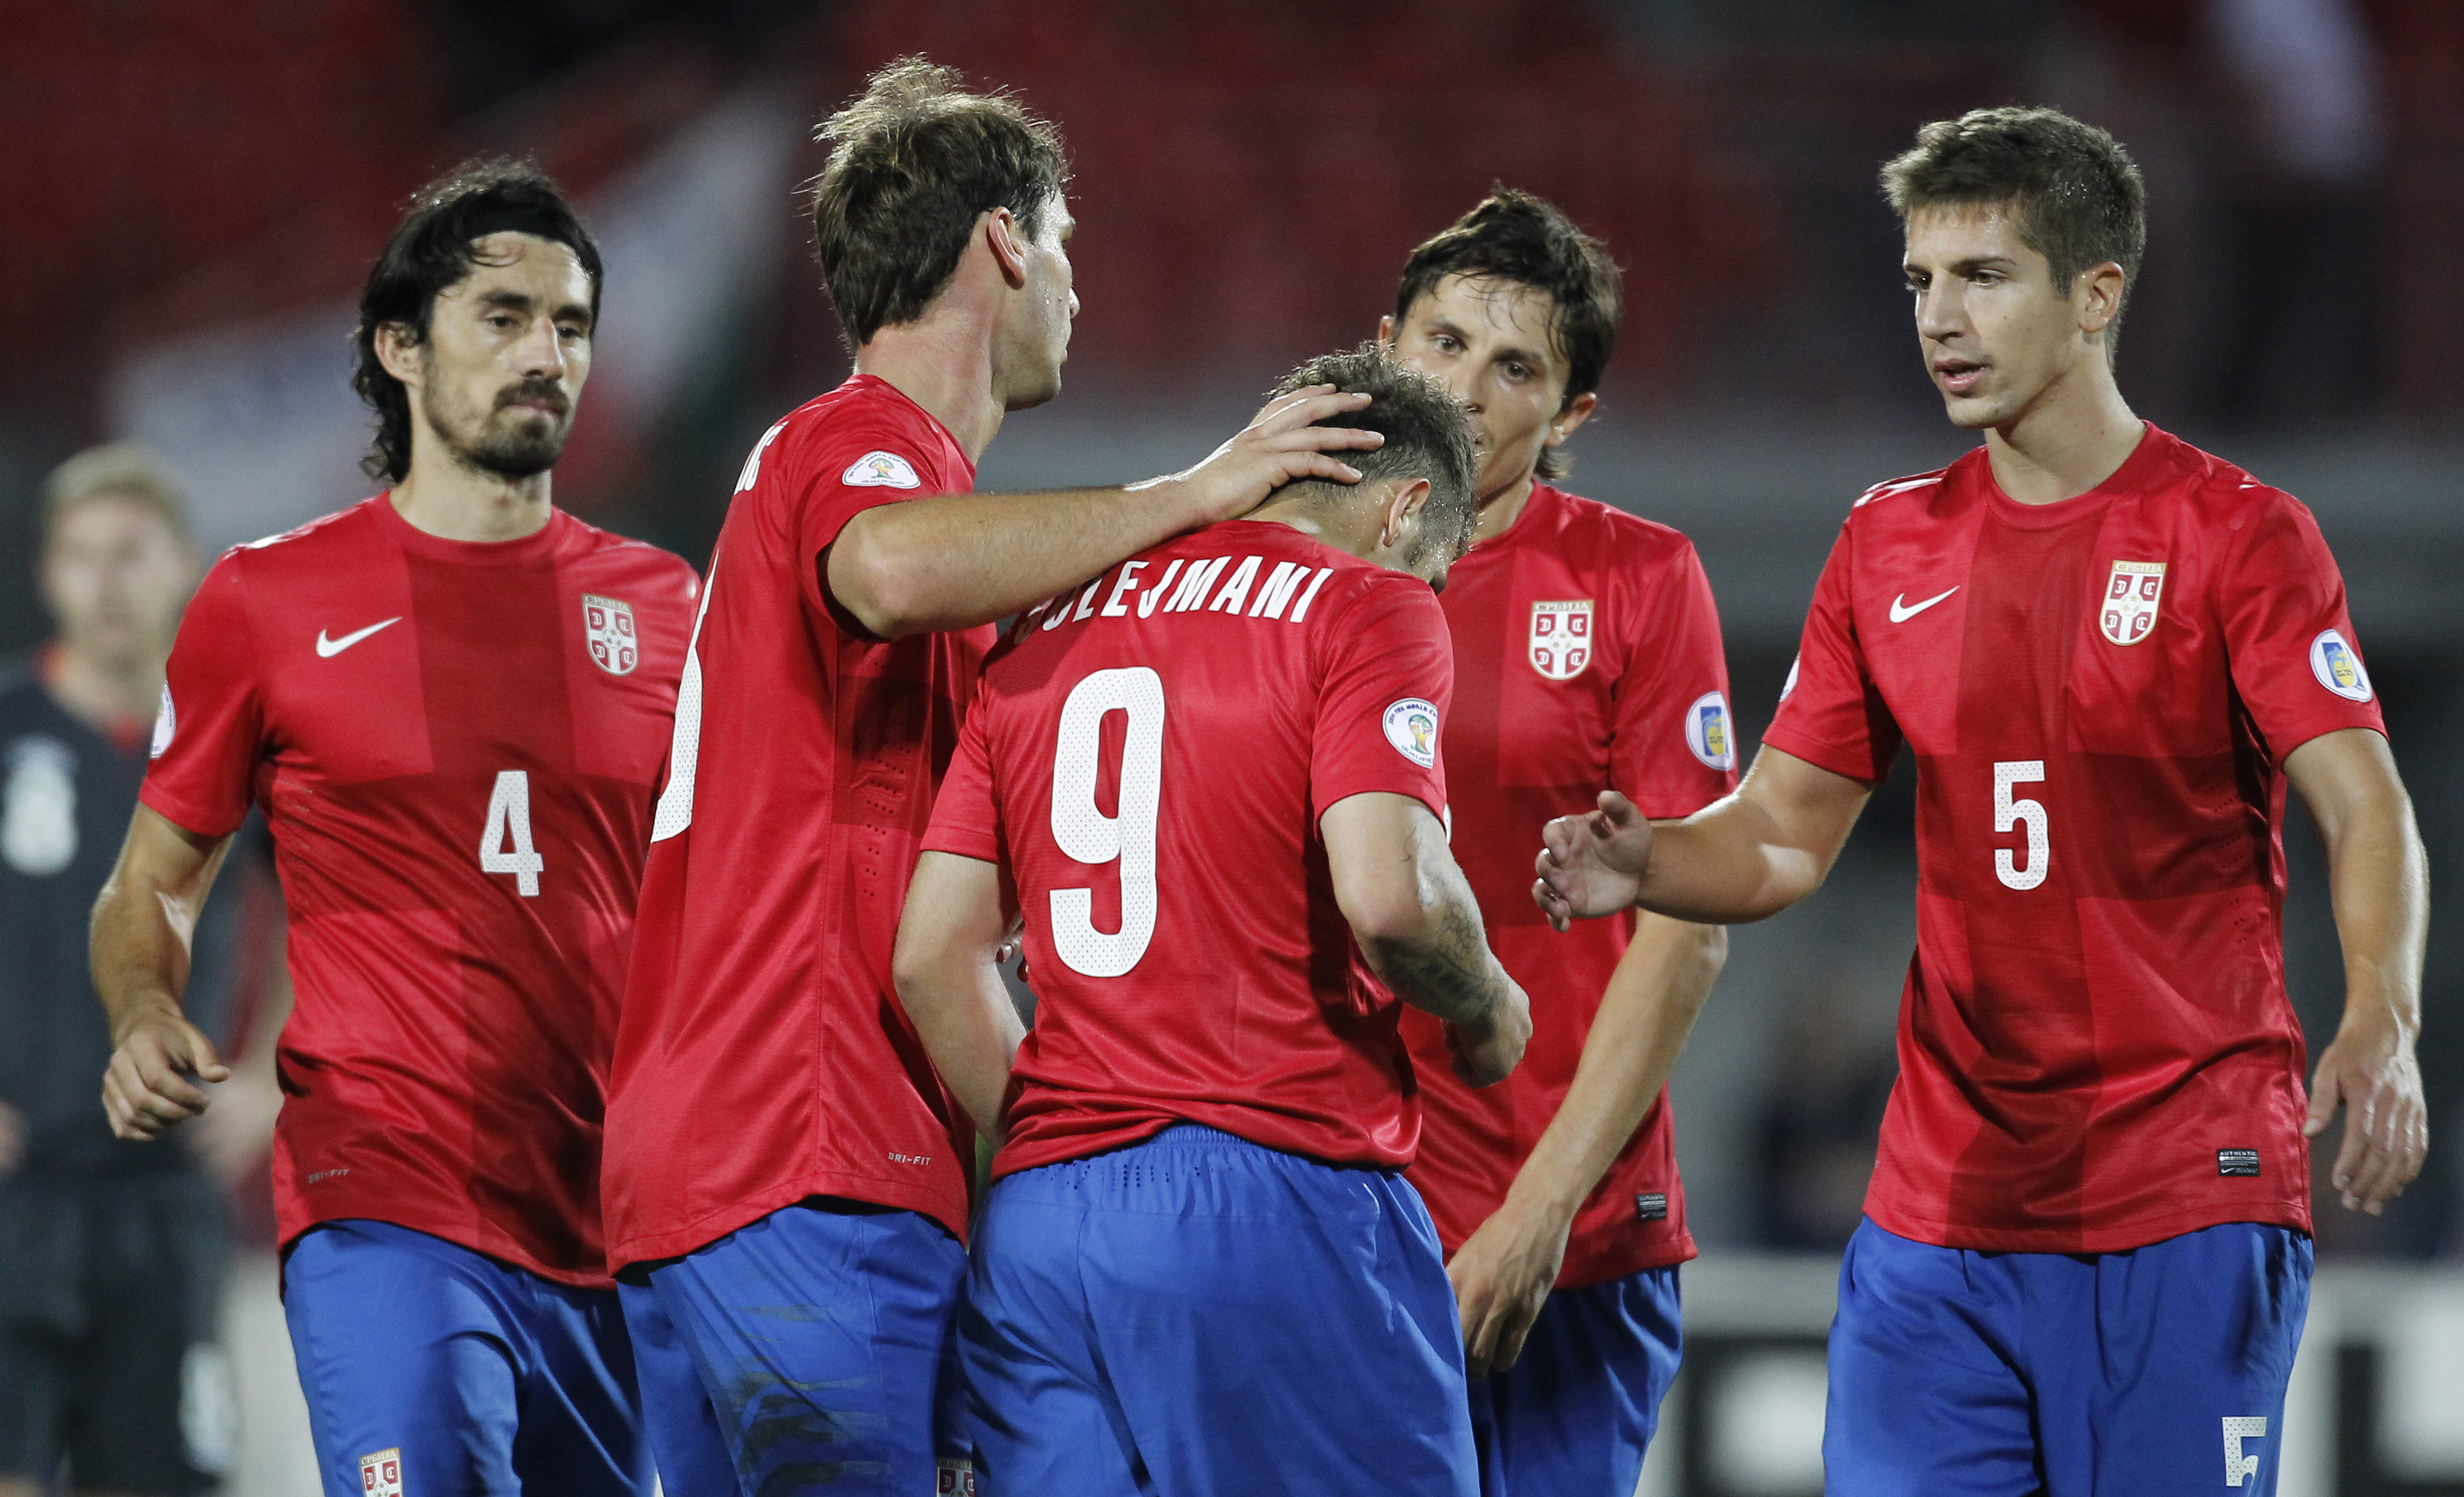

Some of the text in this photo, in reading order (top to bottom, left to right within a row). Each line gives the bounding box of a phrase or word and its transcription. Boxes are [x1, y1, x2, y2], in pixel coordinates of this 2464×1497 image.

[479, 770, 544, 897] 4
[1049, 666, 1166, 978] 9
[1993, 759, 2050, 891] 5
[308, 1168, 350, 1184] DRI-FIT
[888, 1152, 931, 1166] DRI-FIT
